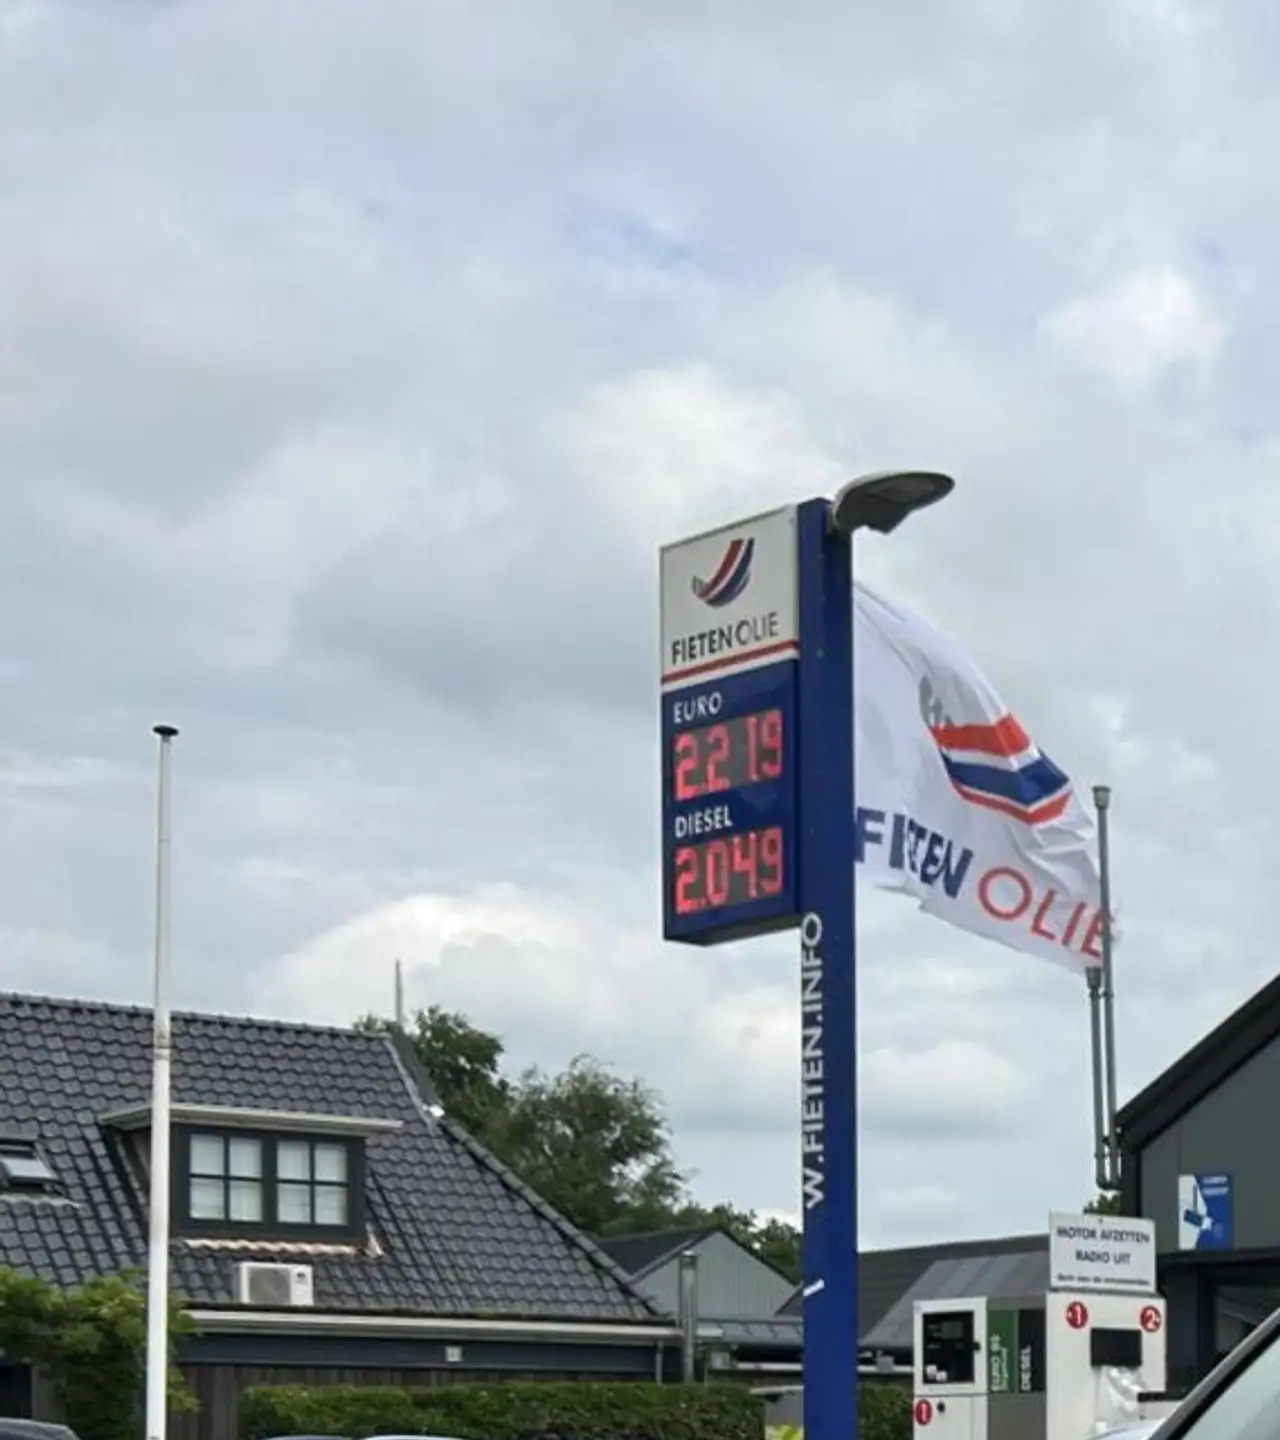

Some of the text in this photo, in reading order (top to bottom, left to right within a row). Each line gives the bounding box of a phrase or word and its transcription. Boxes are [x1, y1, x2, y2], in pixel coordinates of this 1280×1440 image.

[673, 692, 722, 724] EURO
[674, 805, 733, 838] DIESEL
[1057, 1226, 1097, 1240] MOTOR
[1075, 1249, 1131, 1265] RADIO UIT
